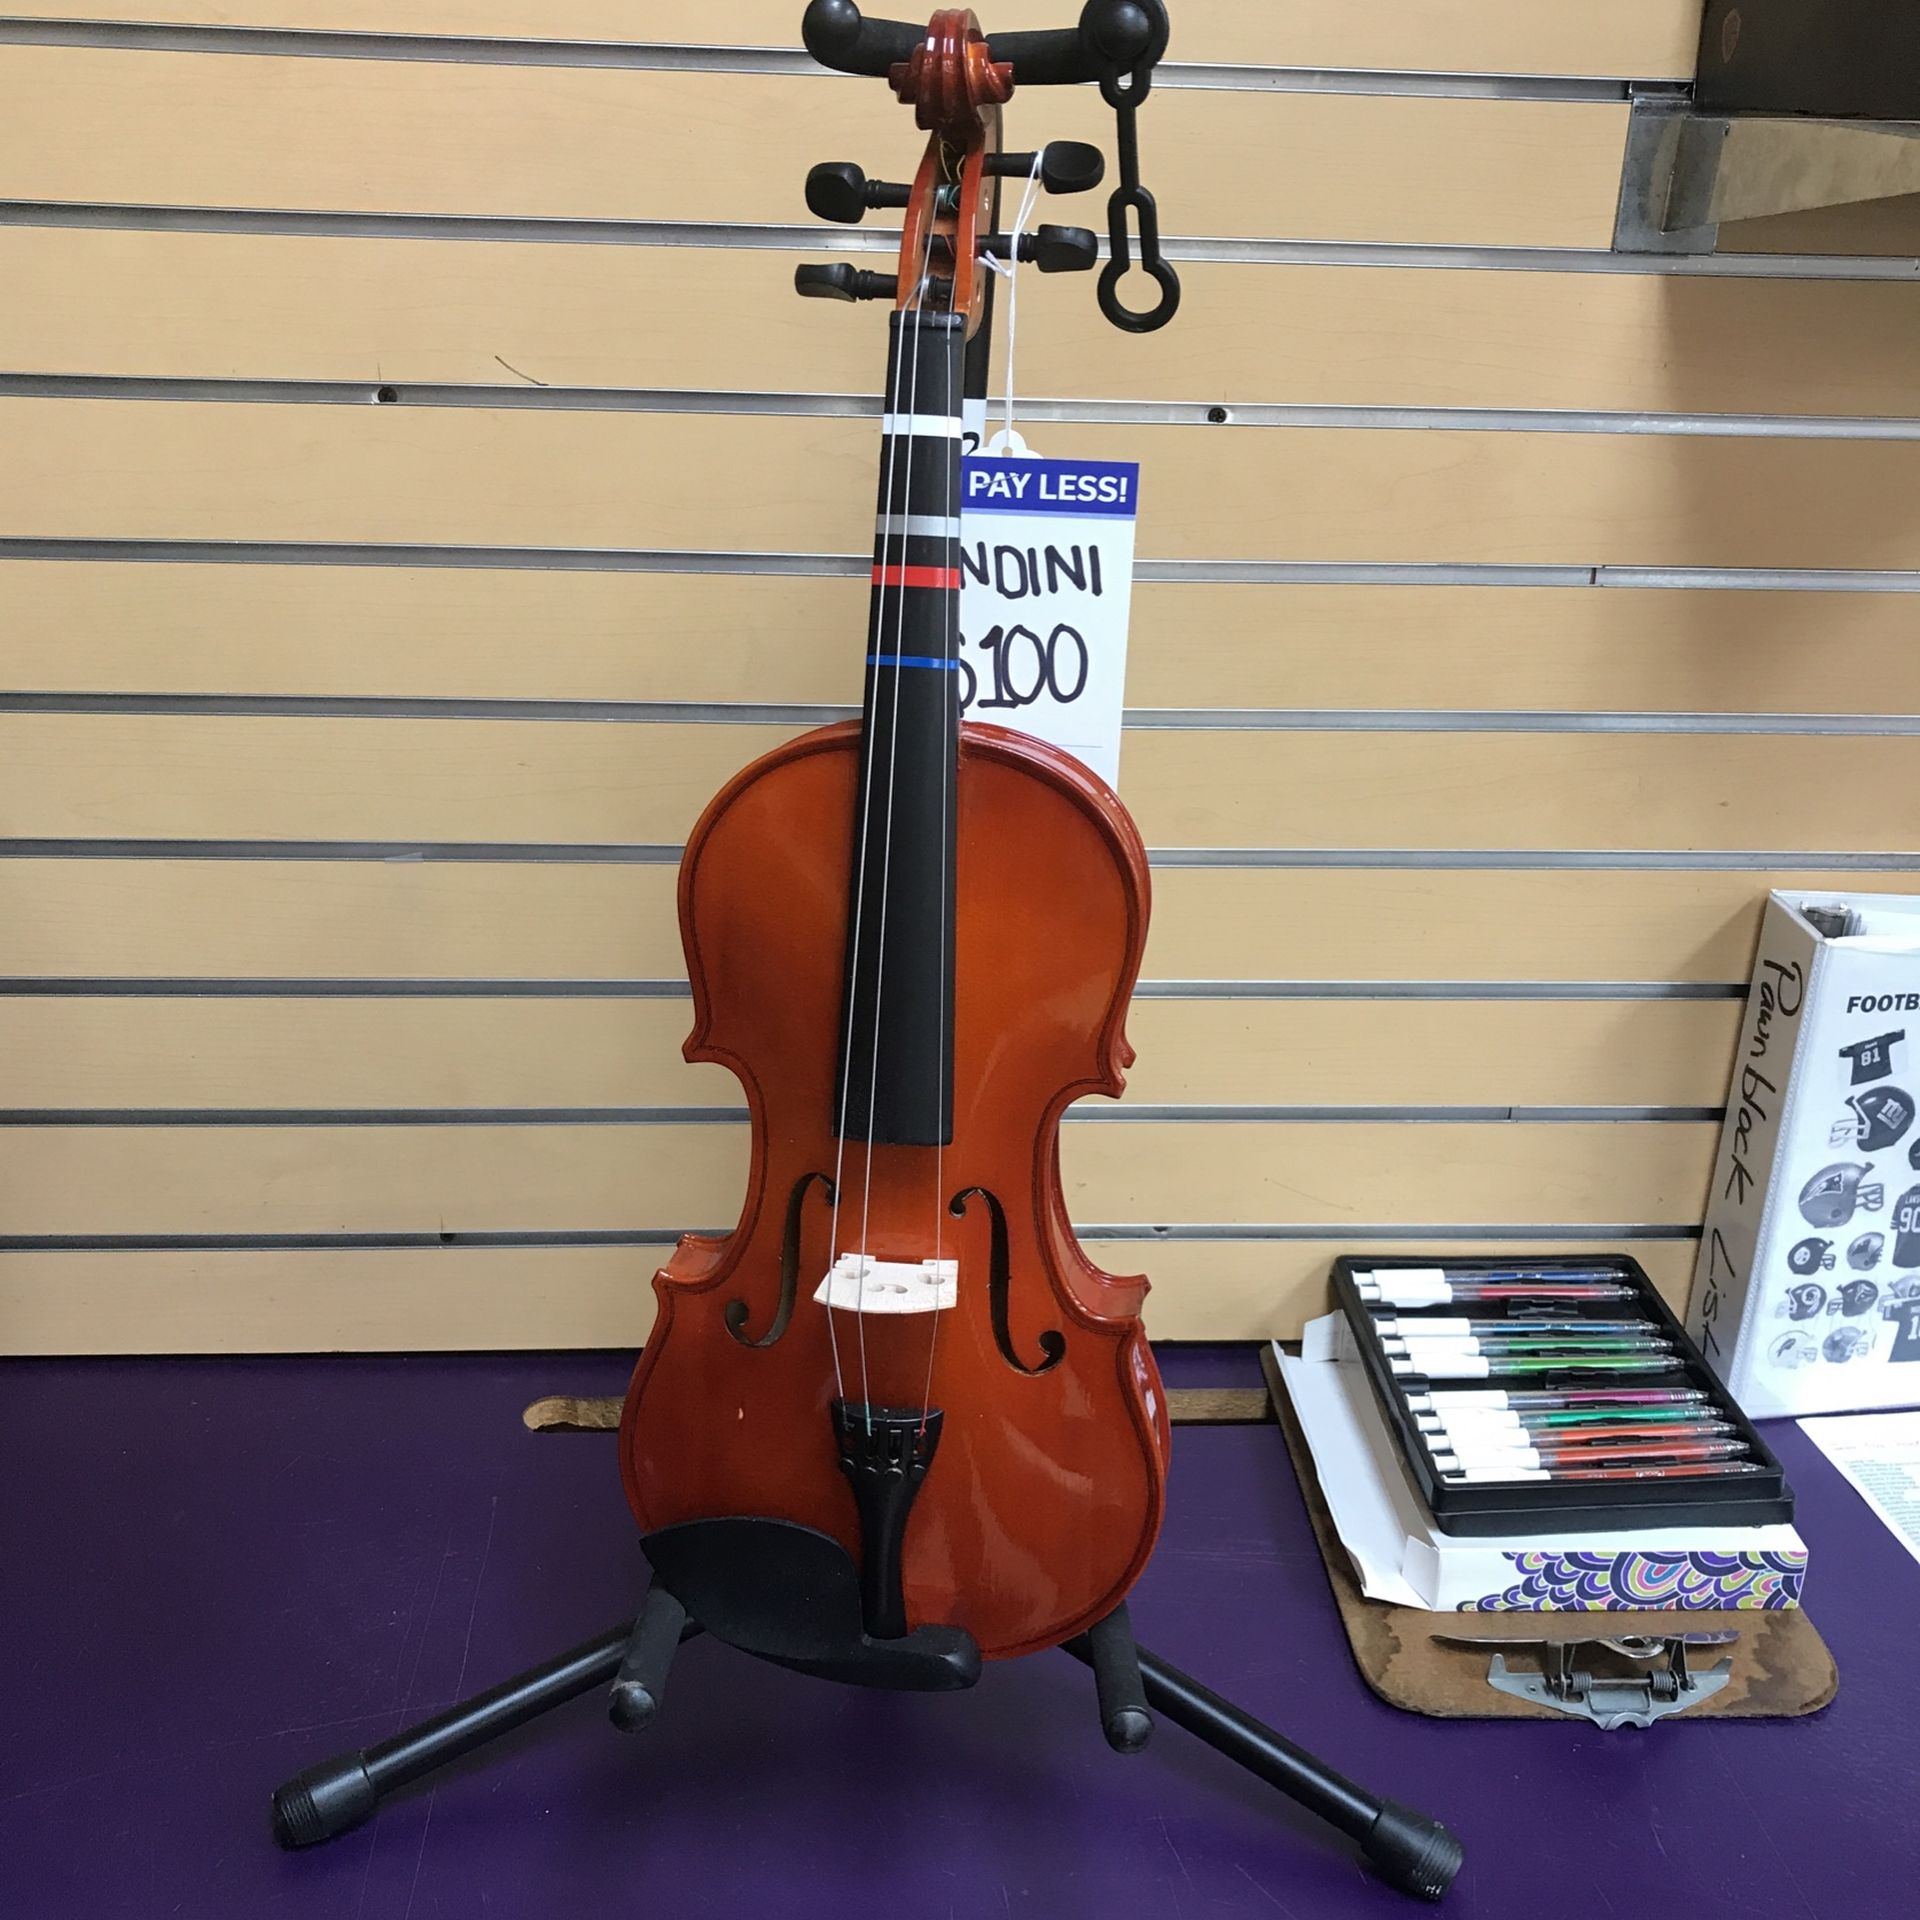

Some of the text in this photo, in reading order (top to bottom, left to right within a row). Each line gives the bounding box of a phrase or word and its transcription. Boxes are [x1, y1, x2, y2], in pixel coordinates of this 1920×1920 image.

[969, 470, 1128, 503] PAY LESS!
[1846, 993, 1920, 1014] FOOTB
[1861, 1047, 1881, 1067] 81
